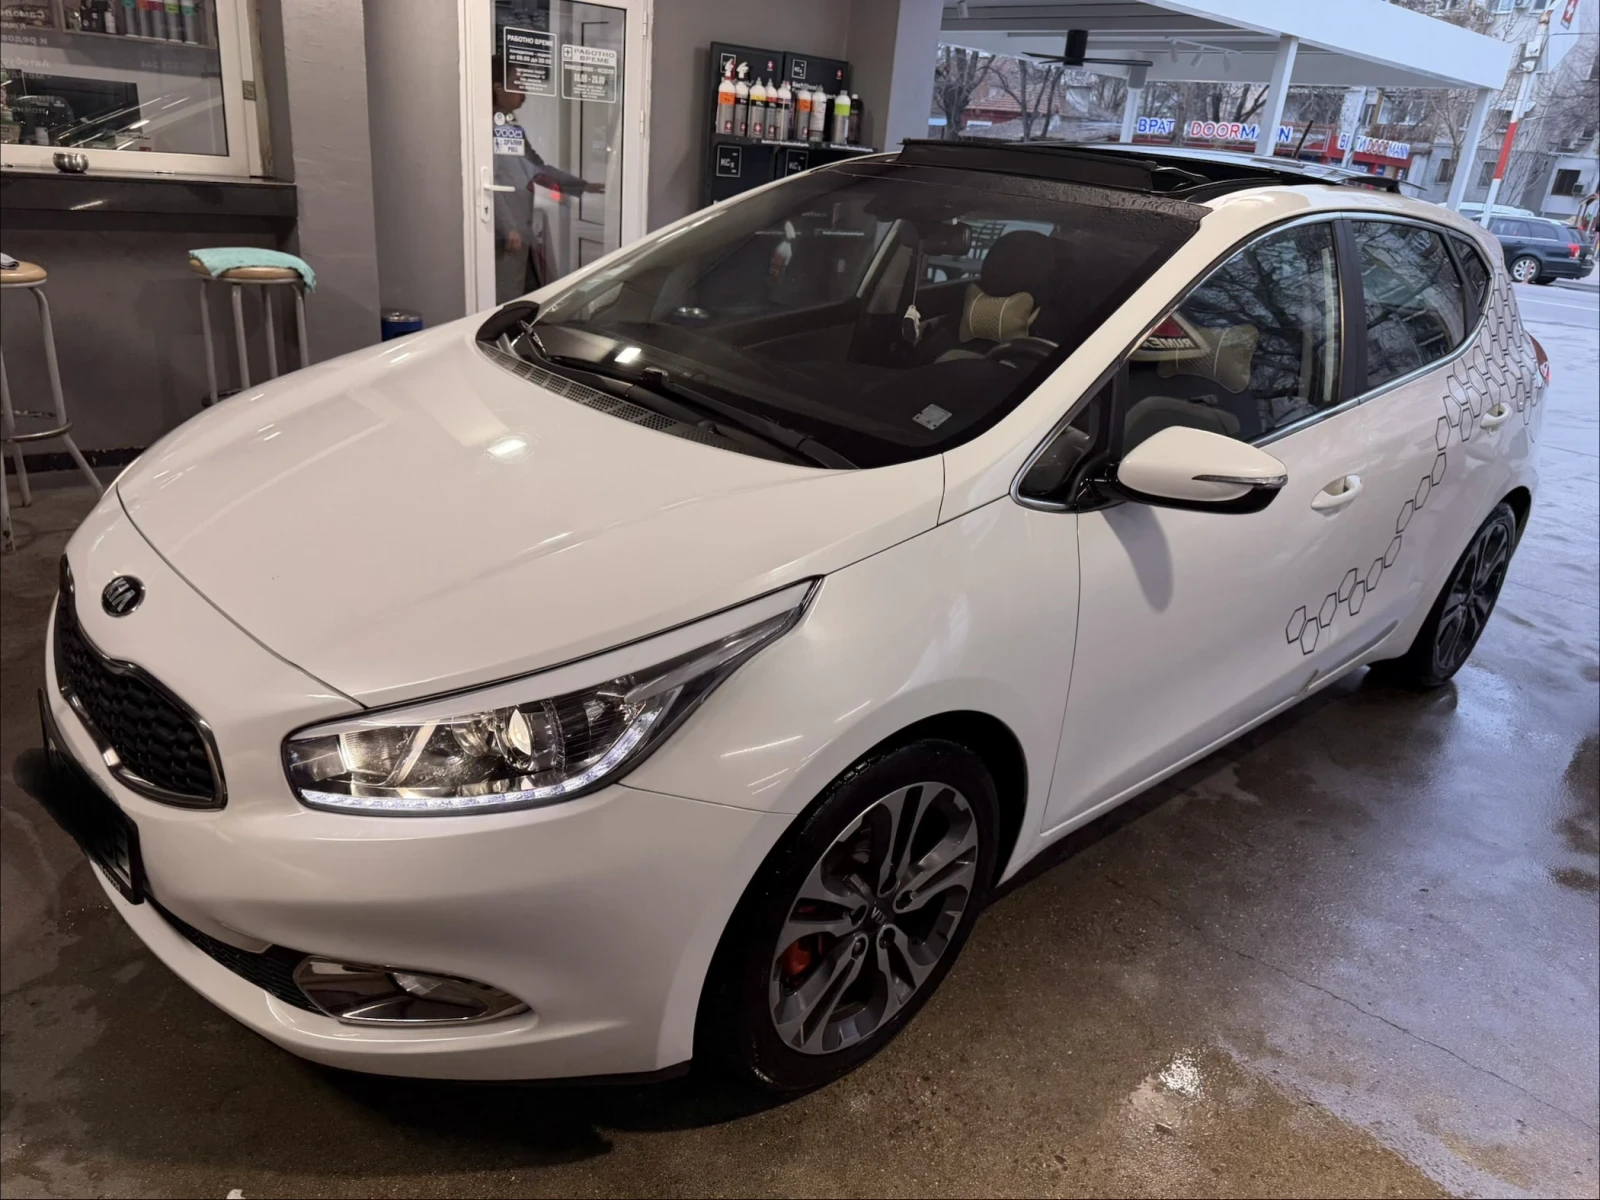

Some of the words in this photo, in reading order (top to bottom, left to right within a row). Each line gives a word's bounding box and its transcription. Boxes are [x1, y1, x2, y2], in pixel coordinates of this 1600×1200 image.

[507, 34, 534, 43] РАБОТНО
[574, 48, 615, 58] РАБОТНО
[580, 55, 609, 64] ВРЕМЕ
[1137, 118, 1188, 135] ВРАТ
[1190, 121, 1292, 142] DOORMN
